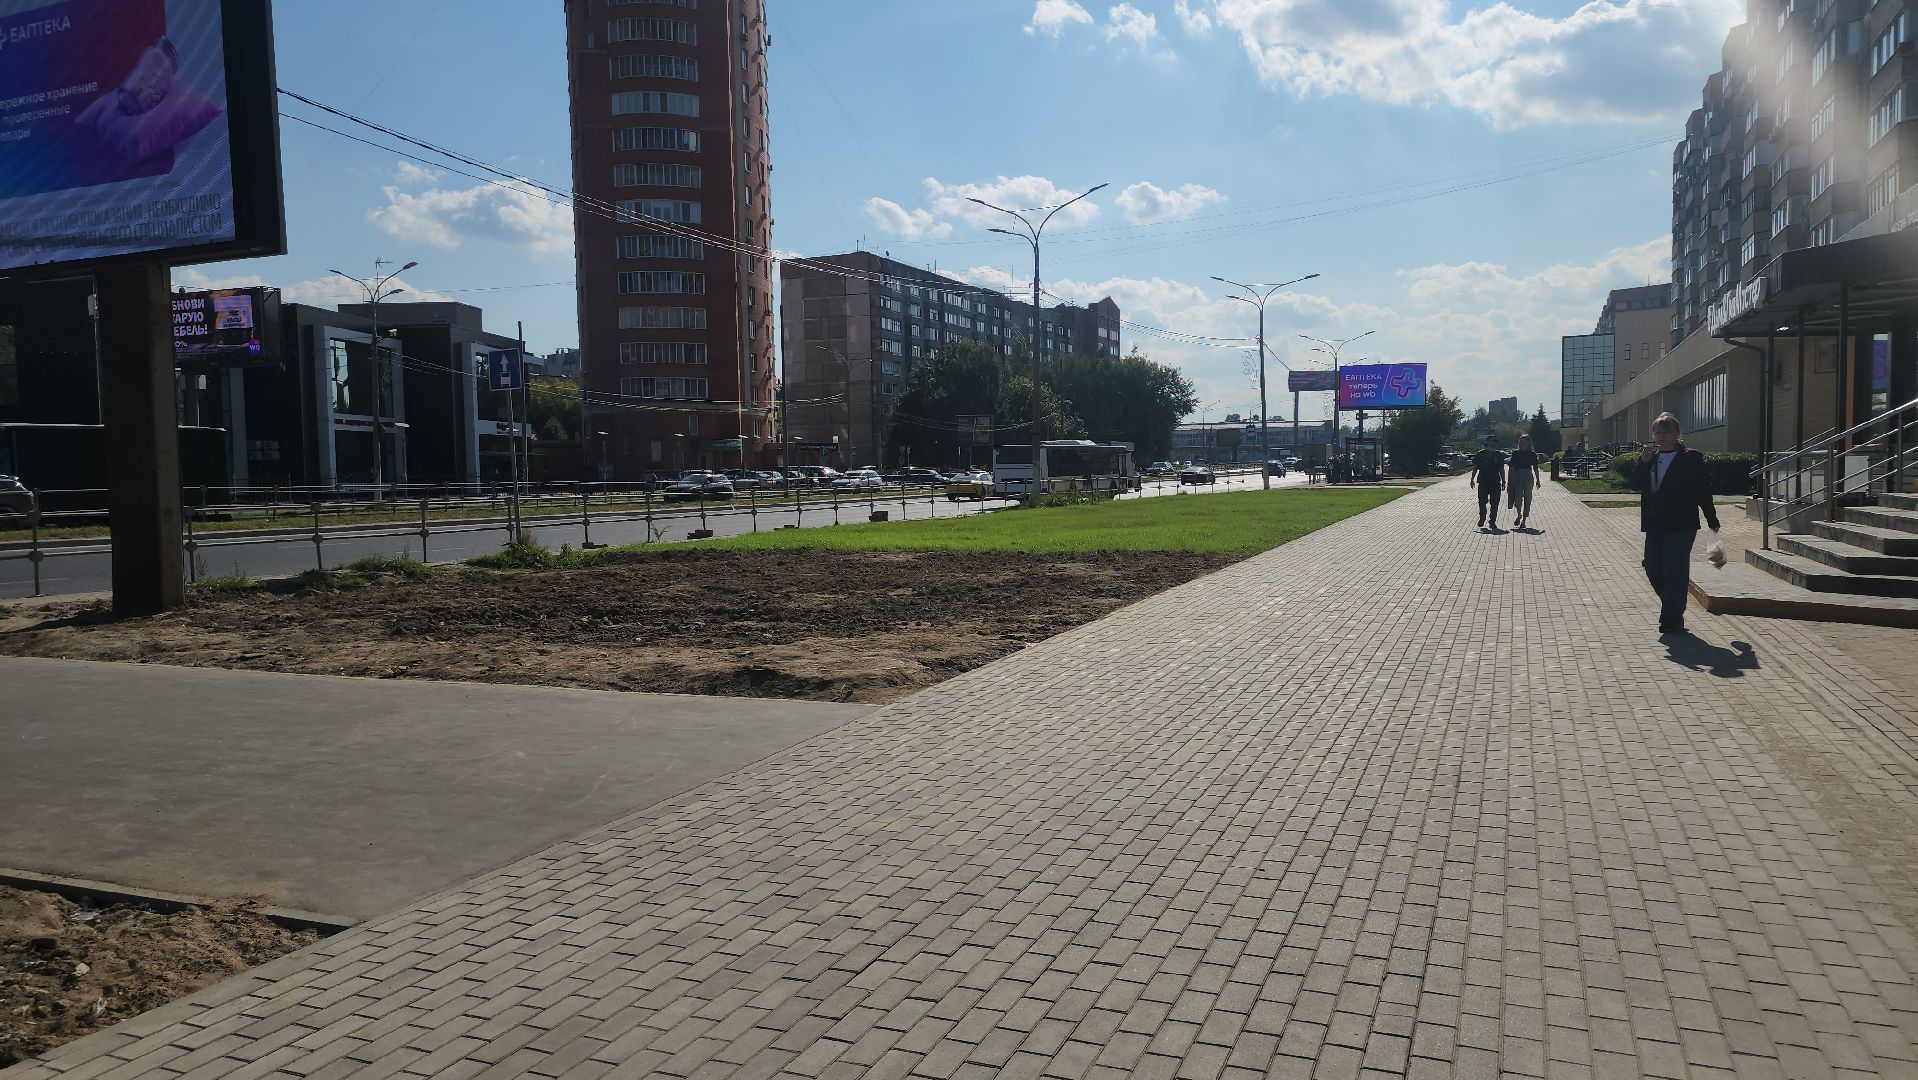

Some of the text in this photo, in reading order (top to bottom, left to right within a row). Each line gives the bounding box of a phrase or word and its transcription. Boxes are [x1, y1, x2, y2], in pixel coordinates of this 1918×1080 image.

[10, 15, 72, 43] ЕАПТЕКА
[47, 81, 98, 102] хранение
[2, 103, 71, 127] проверенные
[1345, 373, 1382, 381] ЕАПТЕКА
